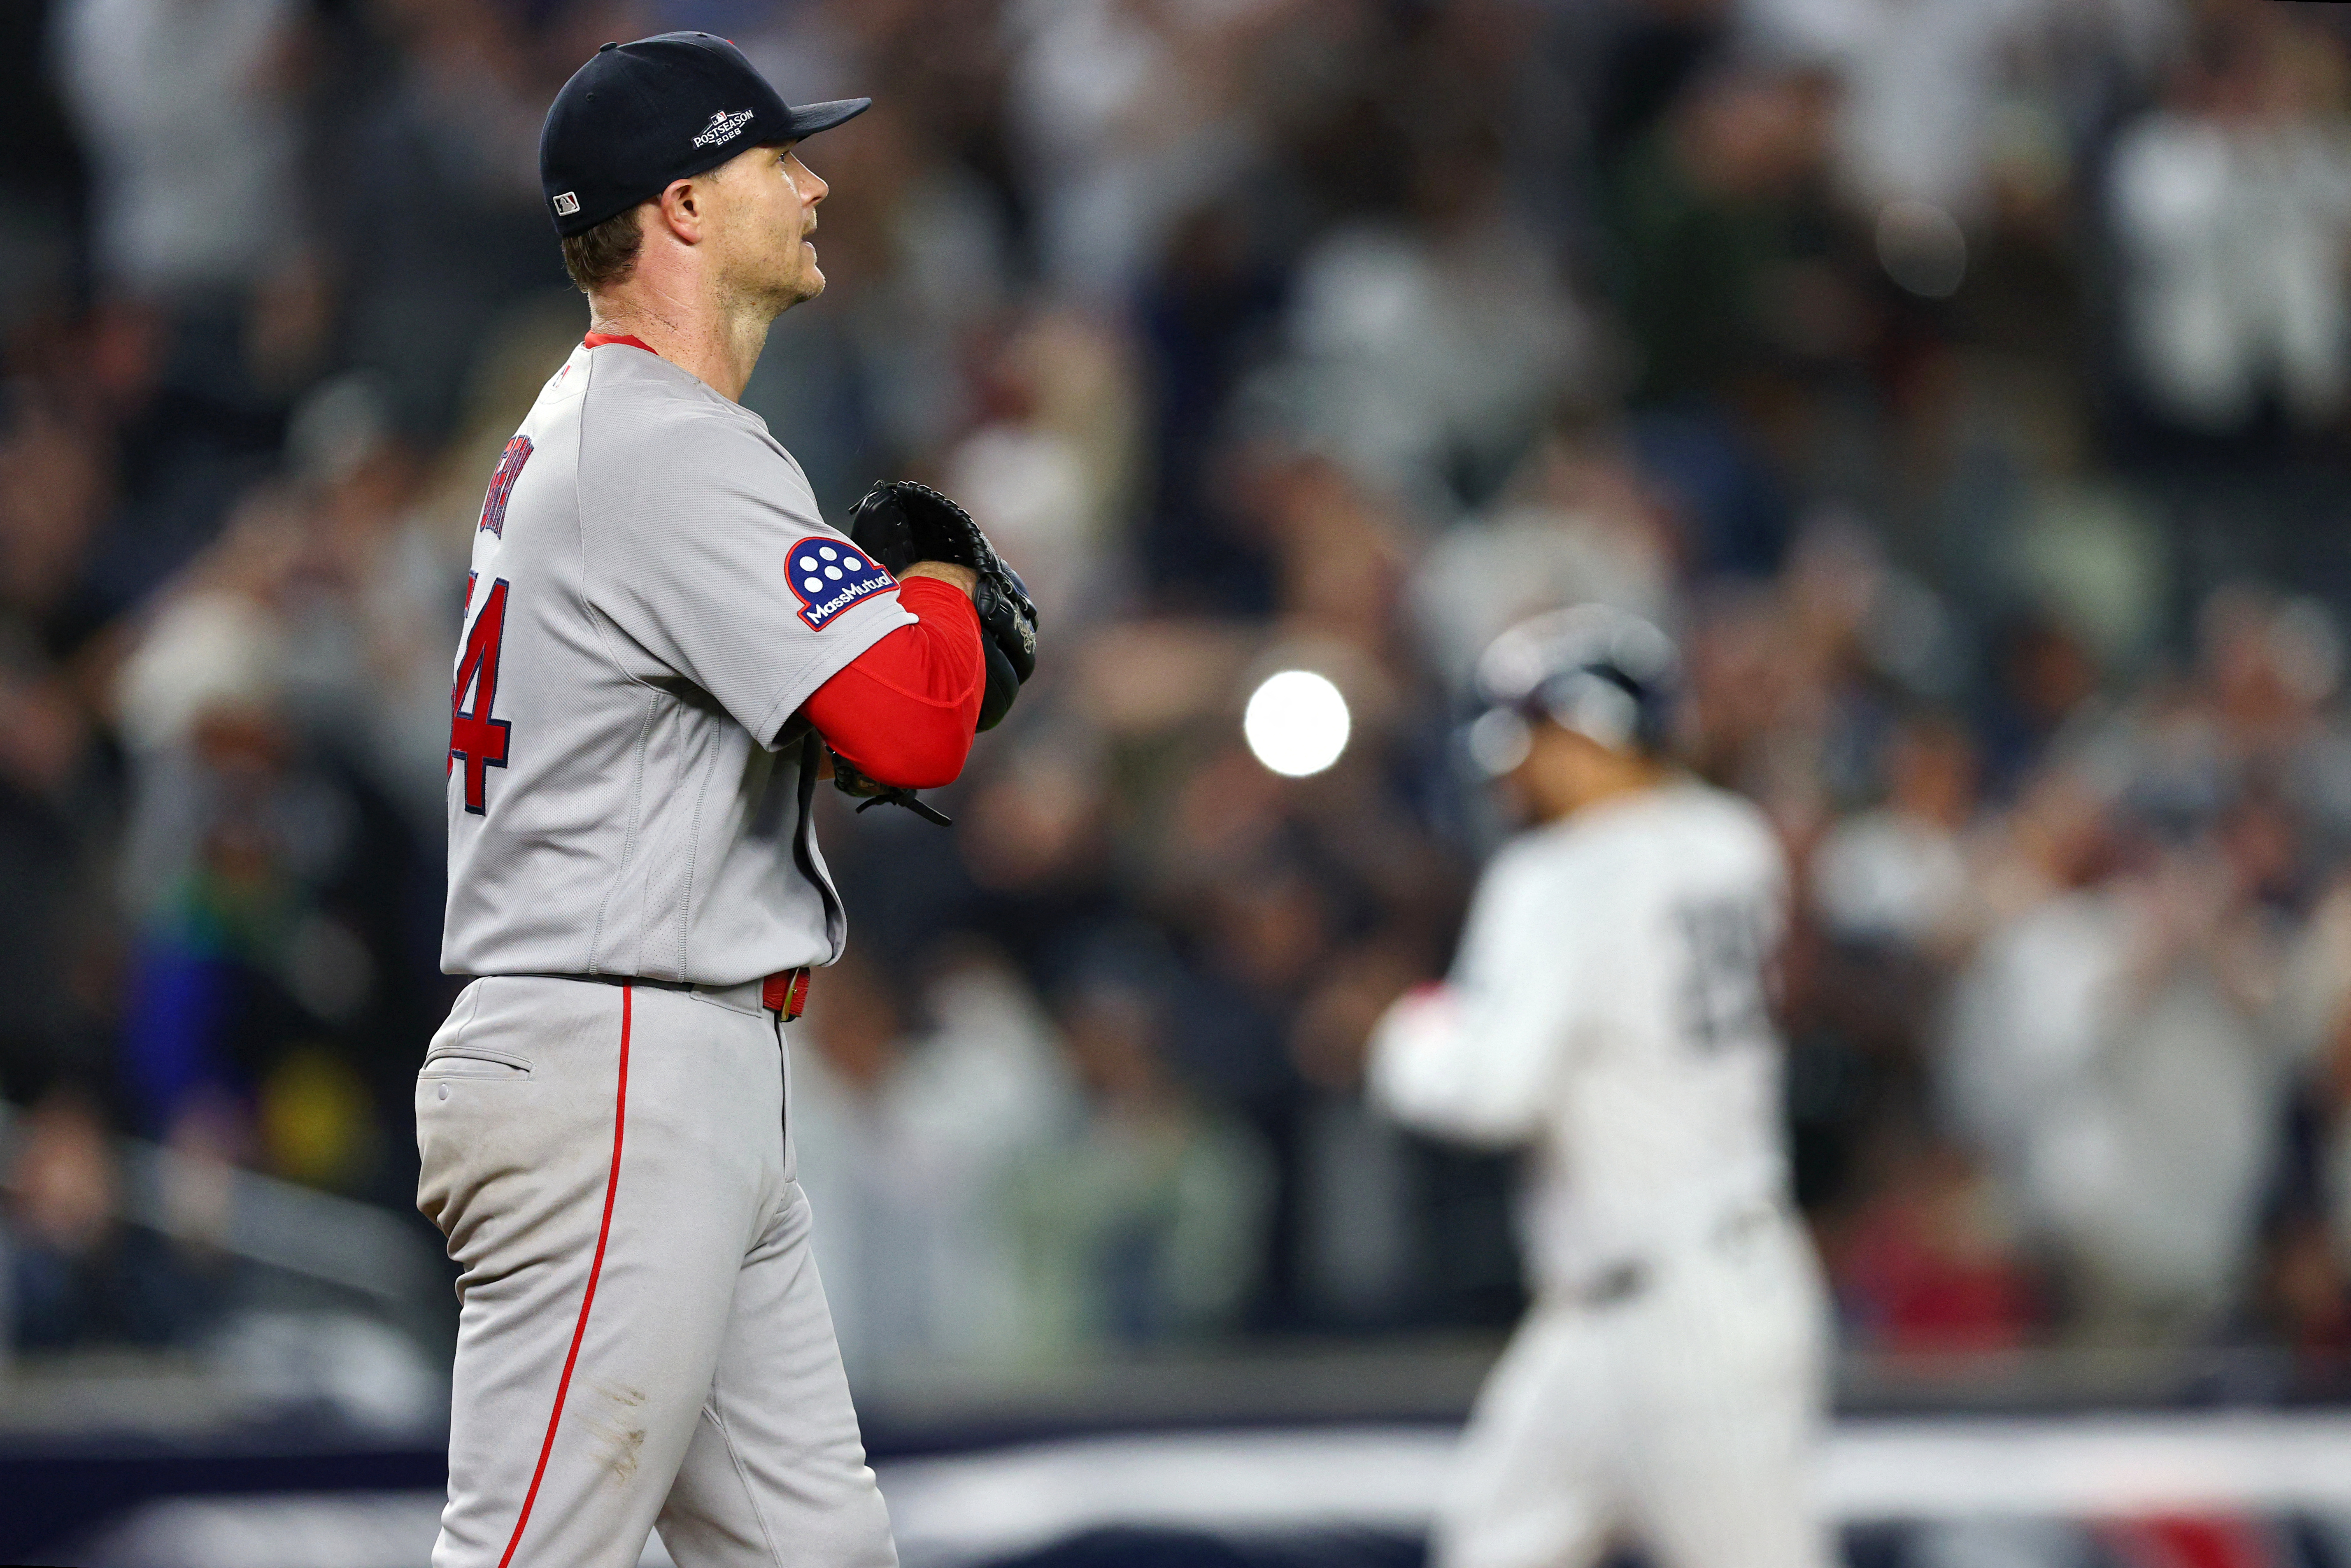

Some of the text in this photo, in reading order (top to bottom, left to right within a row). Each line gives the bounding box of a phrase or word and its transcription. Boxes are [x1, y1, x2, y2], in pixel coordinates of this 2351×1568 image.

[693, 109, 754, 148] POSTSEASON
[716, 128, 741, 146] 2026
[806, 571, 893, 624] MassMutual
